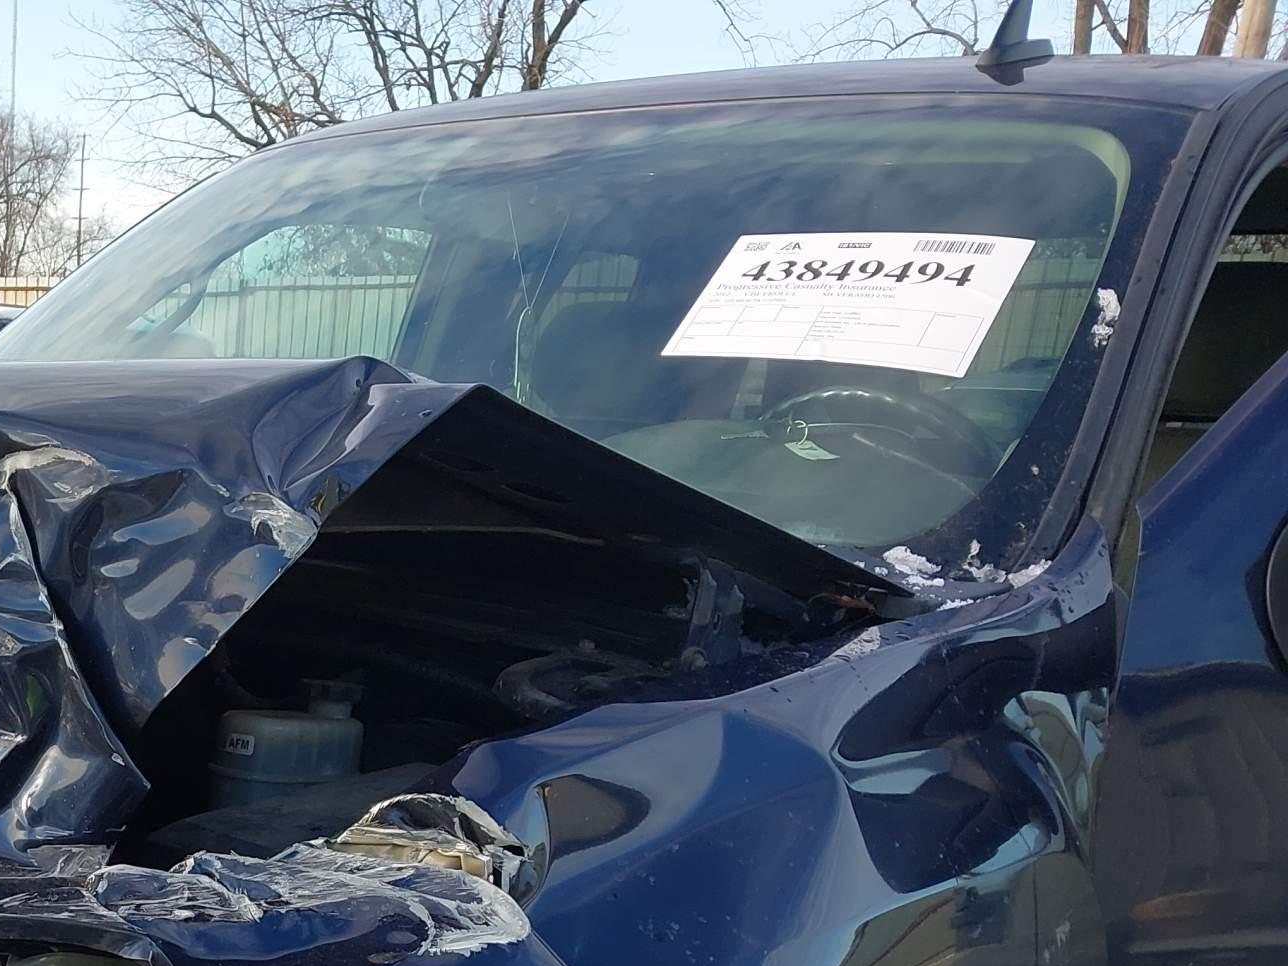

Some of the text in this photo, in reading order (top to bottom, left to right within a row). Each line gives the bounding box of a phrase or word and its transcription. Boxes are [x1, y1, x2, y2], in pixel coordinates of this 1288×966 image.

[741, 259, 976, 287] 43849494
[716, 283, 896, 292] Progressive Casualty Insurance
[228, 737, 250, 751] AFM
